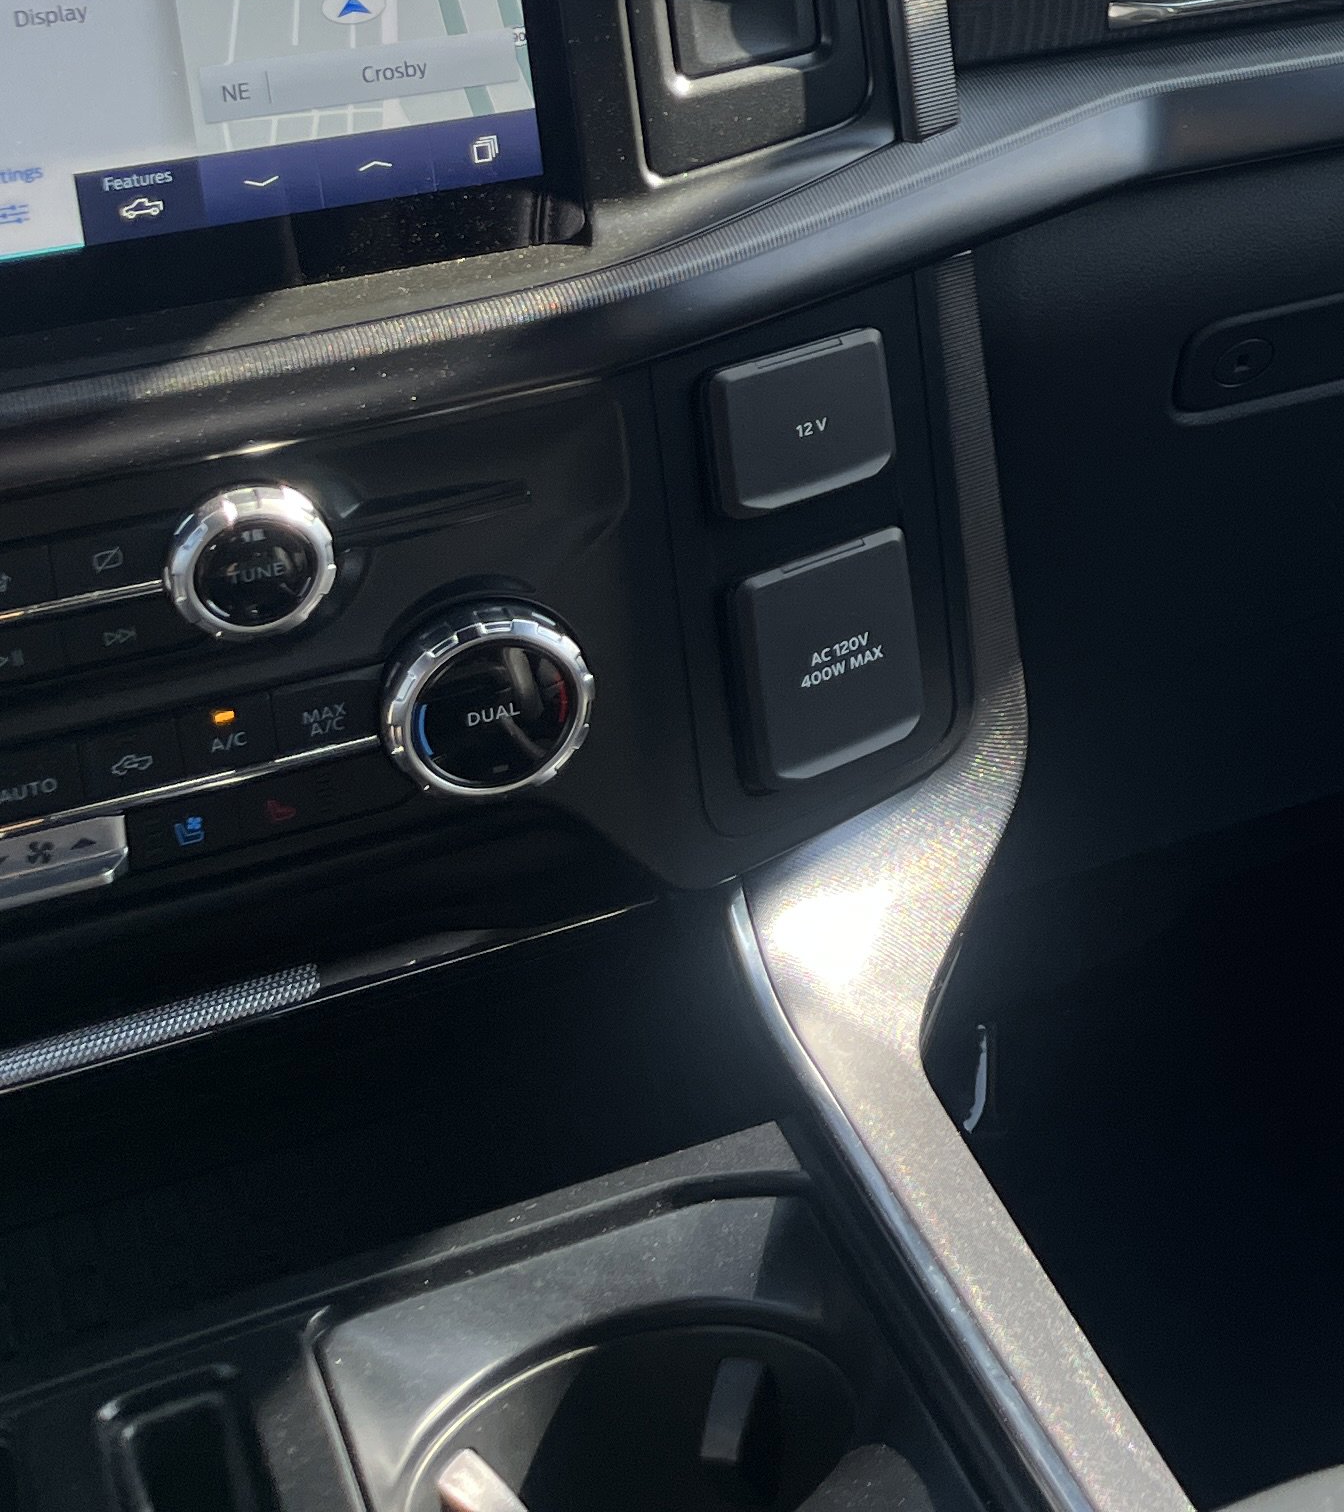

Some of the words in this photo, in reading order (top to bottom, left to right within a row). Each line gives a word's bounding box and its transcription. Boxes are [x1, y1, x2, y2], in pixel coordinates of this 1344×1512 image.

[14, 4, 88, 28] Display
[362, 61, 428, 84] Crosby
[221, 83, 251, 103] NE
[103, 170, 173, 192] Features
[796, 422, 814, 438] 12
[816, 417, 828, 432] V
[229, 561, 285, 584] TUNE
[811, 647, 832, 667] AC
[833, 632, 870, 658] 120V
[800, 661, 846, 689] 400W
[850, 644, 884, 670] MAX
[303, 702, 346, 725] MAX
[467, 702, 520, 727] DUAL
[310, 716, 346, 737] A/C
[211, 731, 248, 753] A/C
[0, 778, 58, 803] AUTO
